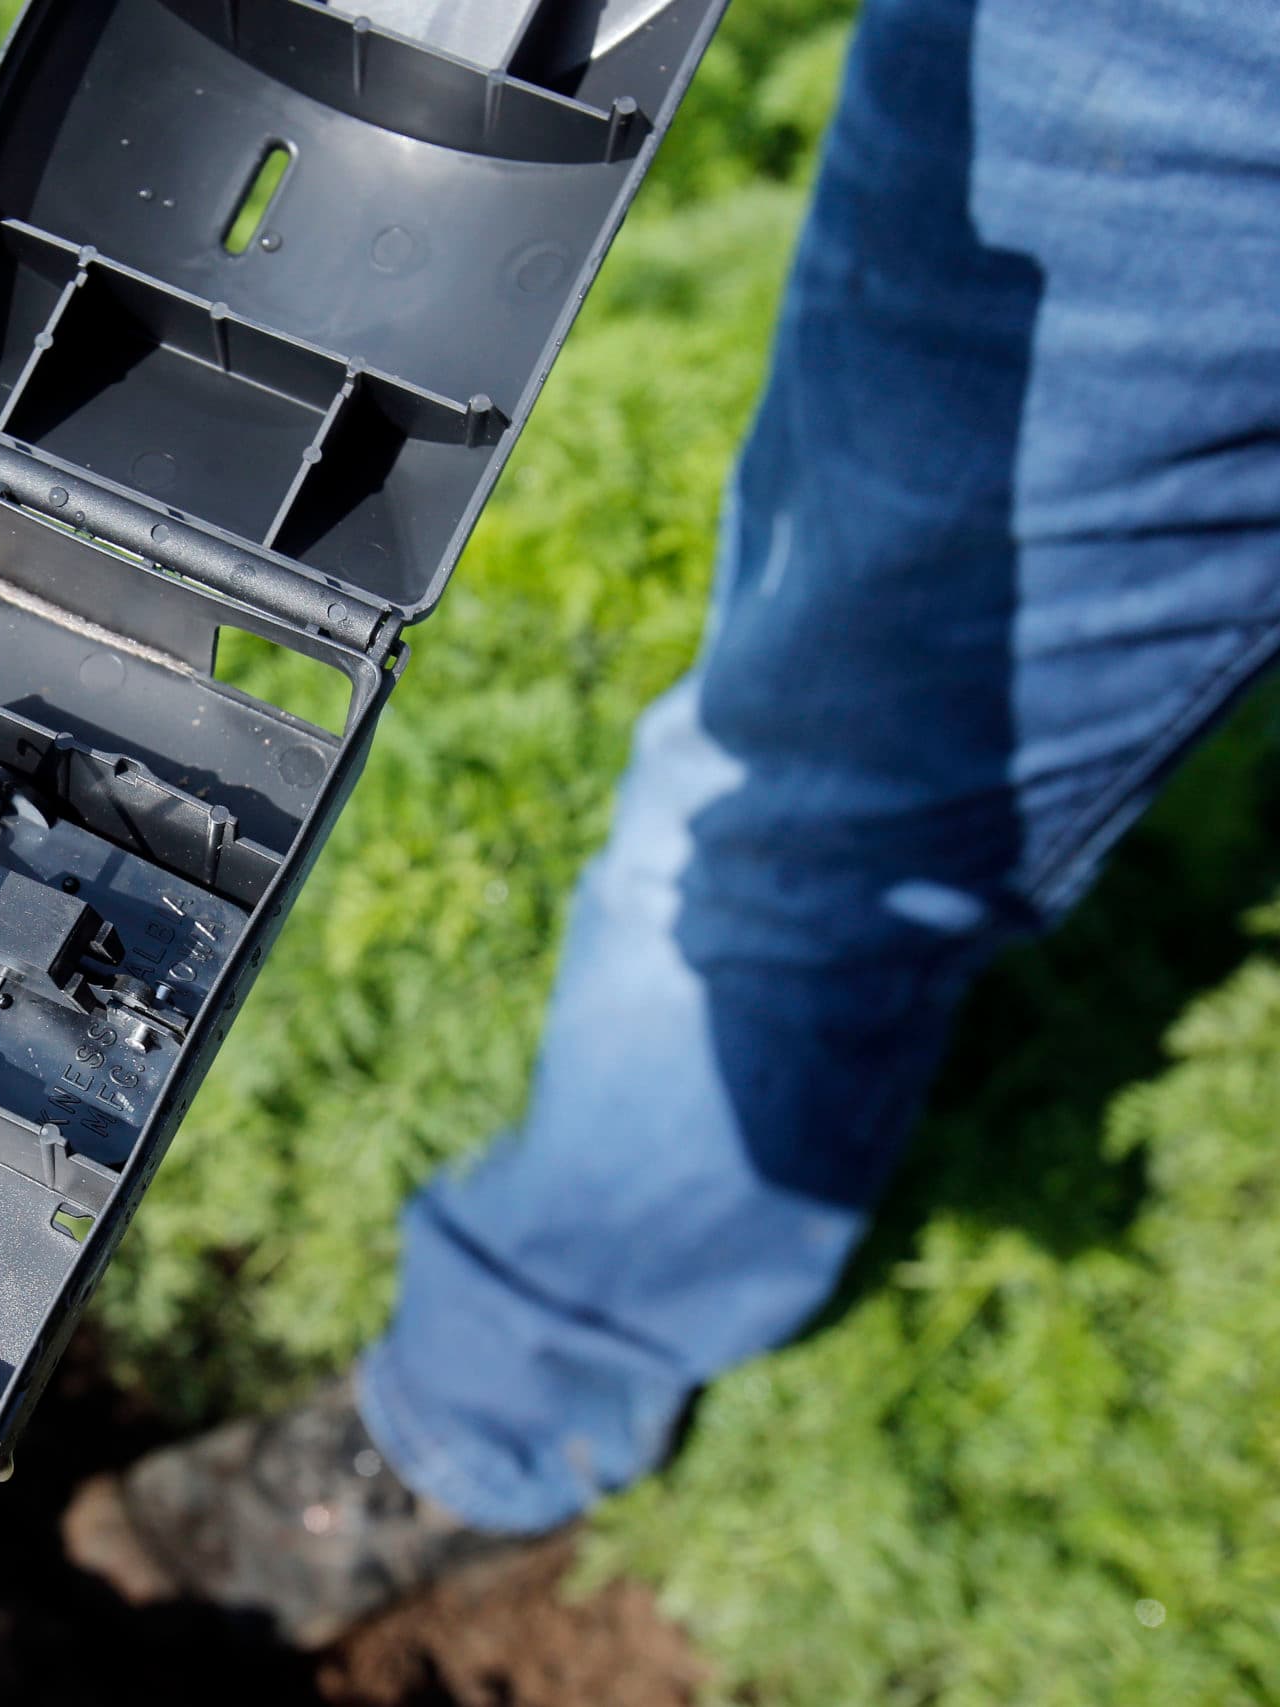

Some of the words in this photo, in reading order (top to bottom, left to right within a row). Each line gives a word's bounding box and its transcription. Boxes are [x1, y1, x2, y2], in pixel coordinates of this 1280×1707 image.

[164, 920, 227, 988] OWA
[37, 1022, 118, 1125] KNESS
[80, 1063, 146, 1137] MFG.
